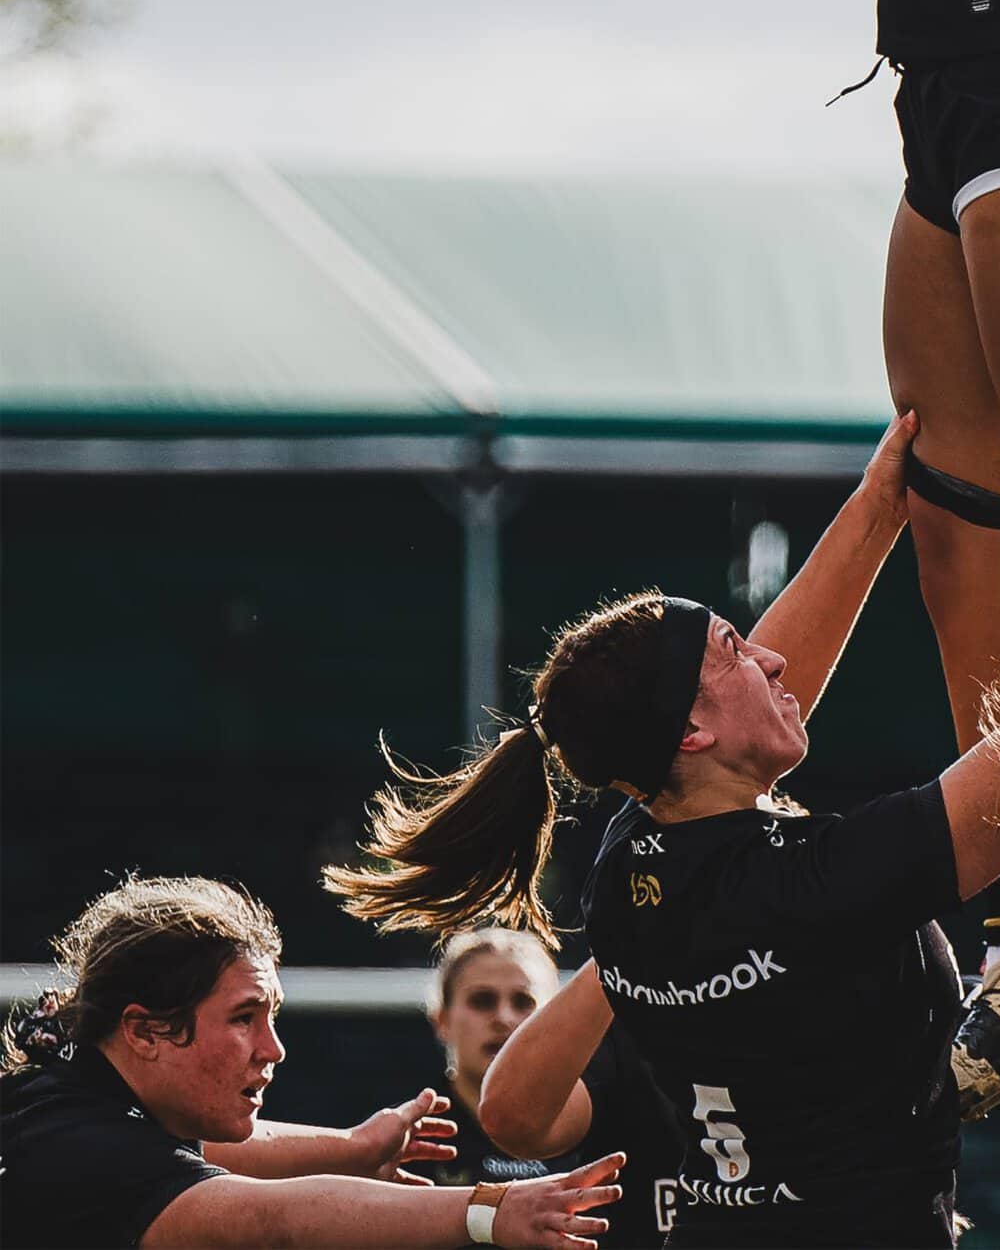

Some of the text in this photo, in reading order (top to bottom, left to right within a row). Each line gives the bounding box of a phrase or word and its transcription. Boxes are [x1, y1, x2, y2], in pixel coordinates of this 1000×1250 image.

[631, 833, 665, 856] neX
[603, 949, 786, 1006] shawbrook
[693, 1083, 751, 1183] 5
